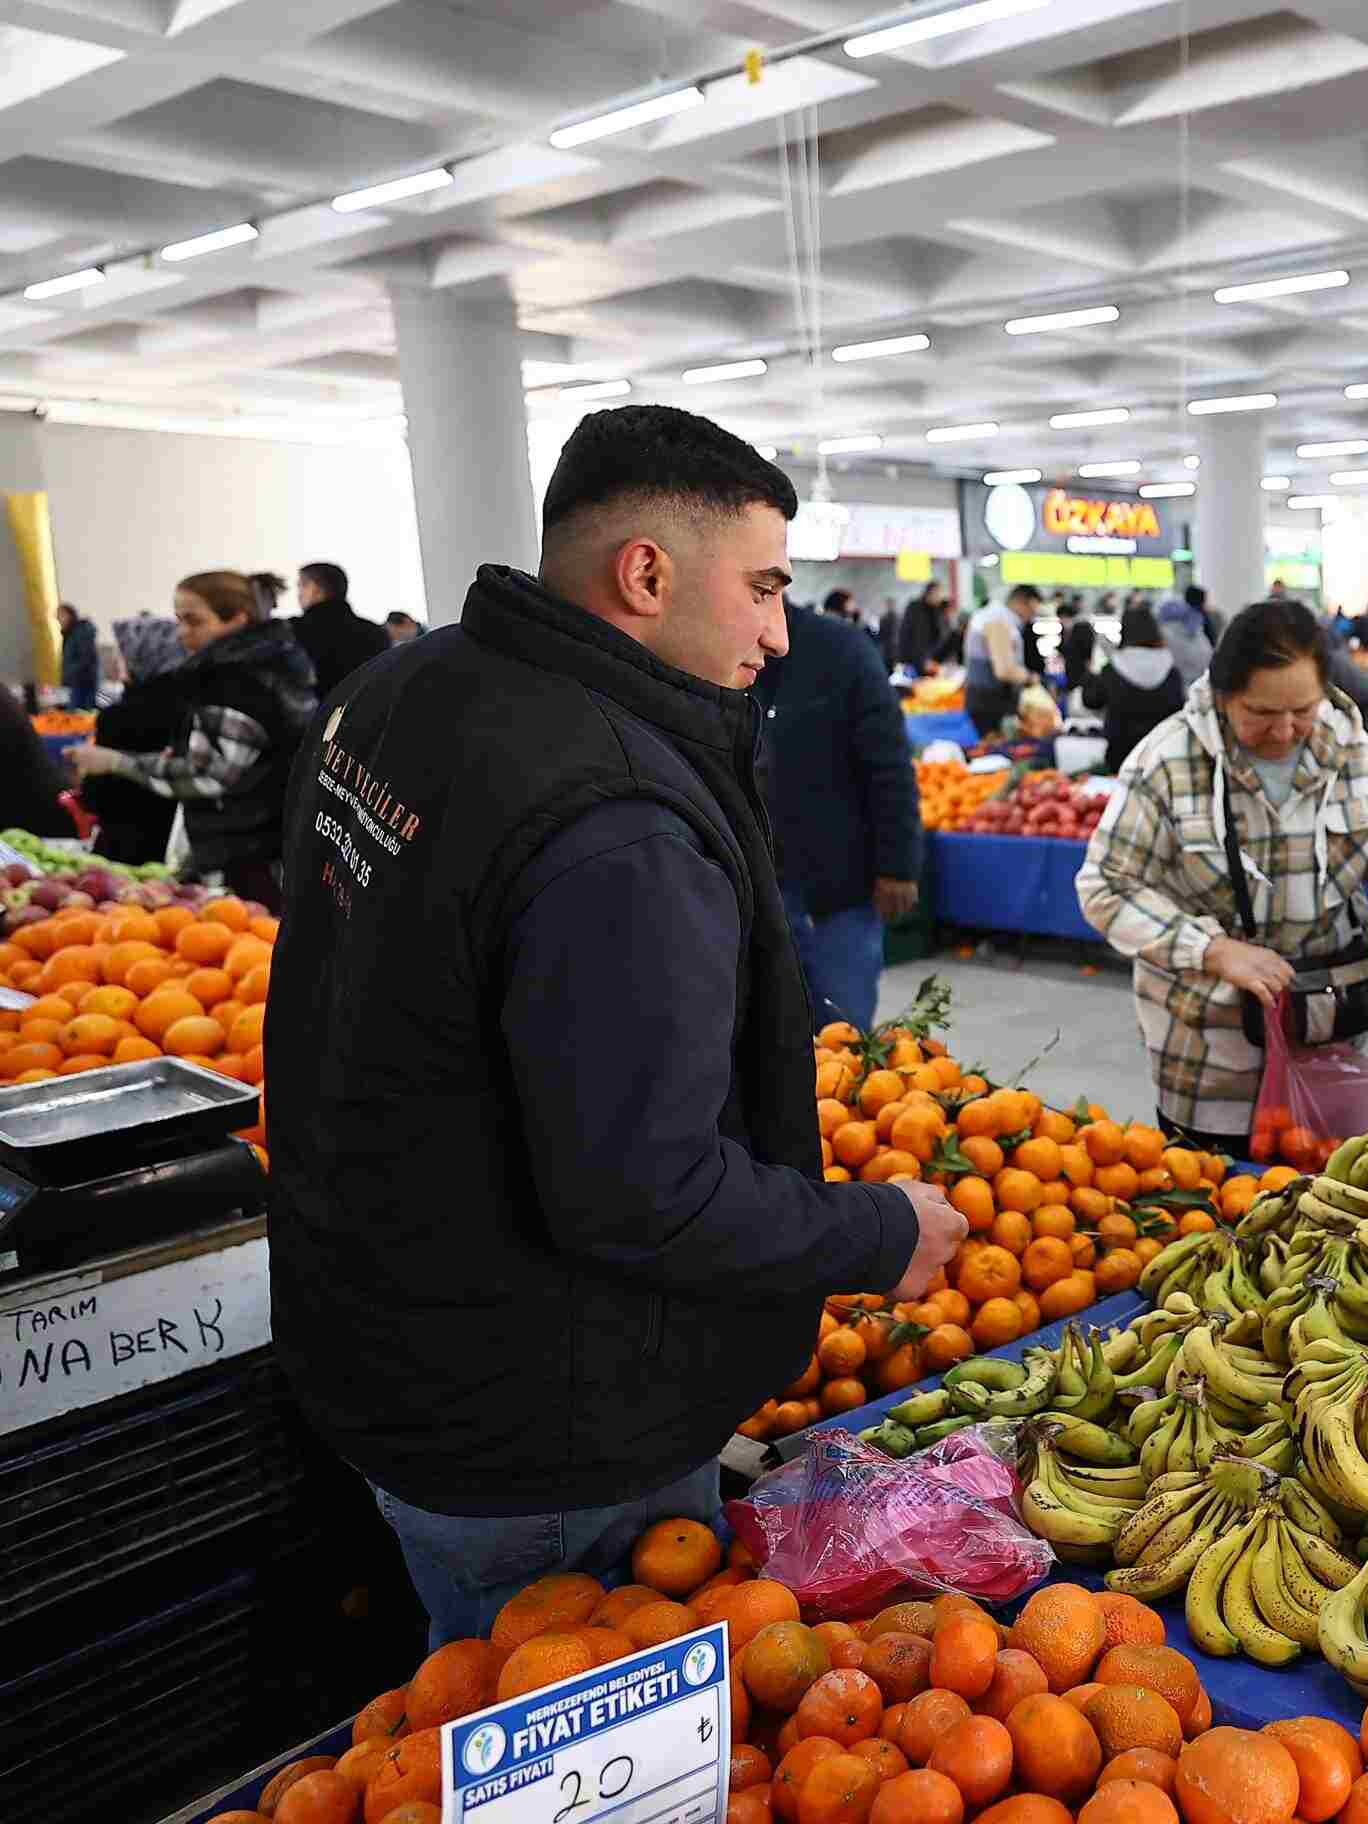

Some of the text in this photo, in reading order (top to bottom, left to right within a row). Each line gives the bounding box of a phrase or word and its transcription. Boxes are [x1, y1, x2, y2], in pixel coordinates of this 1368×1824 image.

[315, 811, 343, 847] 0532
[357, 860, 372, 888] 35
[3, 1297, 97, 1342] TARIM
[0, 1339, 91, 1388] NA
[589, 1668, 679, 1729] ETİKETİ
[552, 1755, 634, 1824] 20
